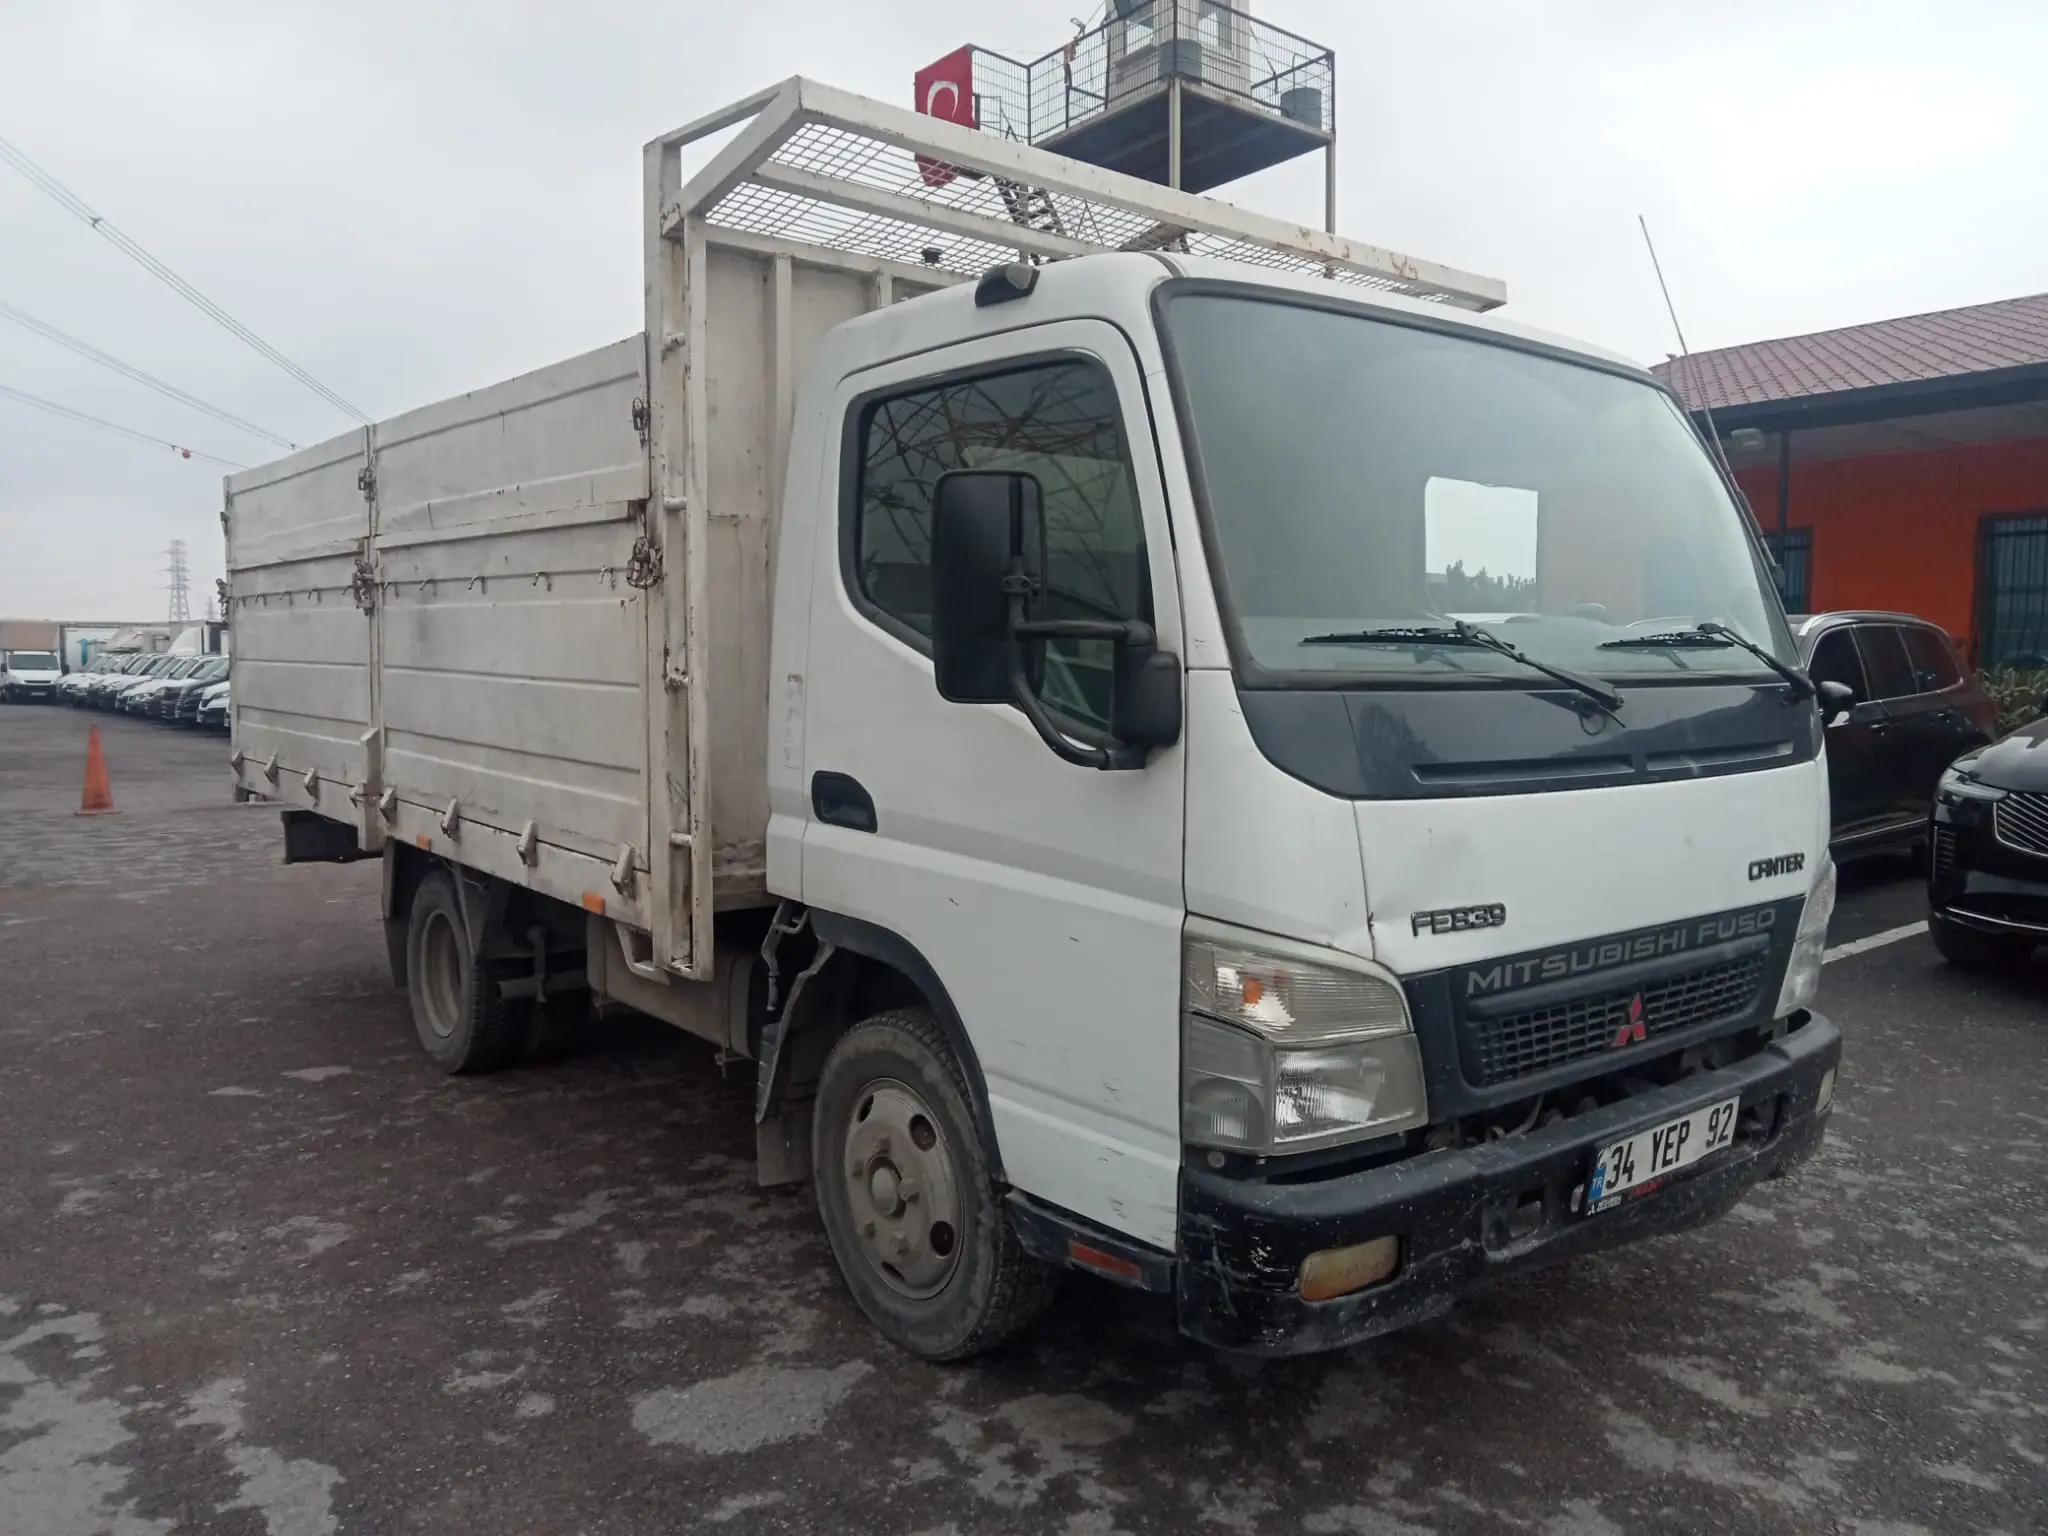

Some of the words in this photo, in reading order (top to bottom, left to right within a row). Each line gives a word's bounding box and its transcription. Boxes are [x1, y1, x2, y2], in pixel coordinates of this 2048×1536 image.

[1748, 852, 1805, 881] CANTER
[1466, 928, 1687, 997] MITSUBISHI
[1698, 908, 1776, 944] FUSO
[1606, 1141, 1635, 1189] 34
[1652, 1120, 1690, 1172] YEP
[1705, 1103, 1734, 1148] 92
[1592, 1175, 1604, 1189] TR
